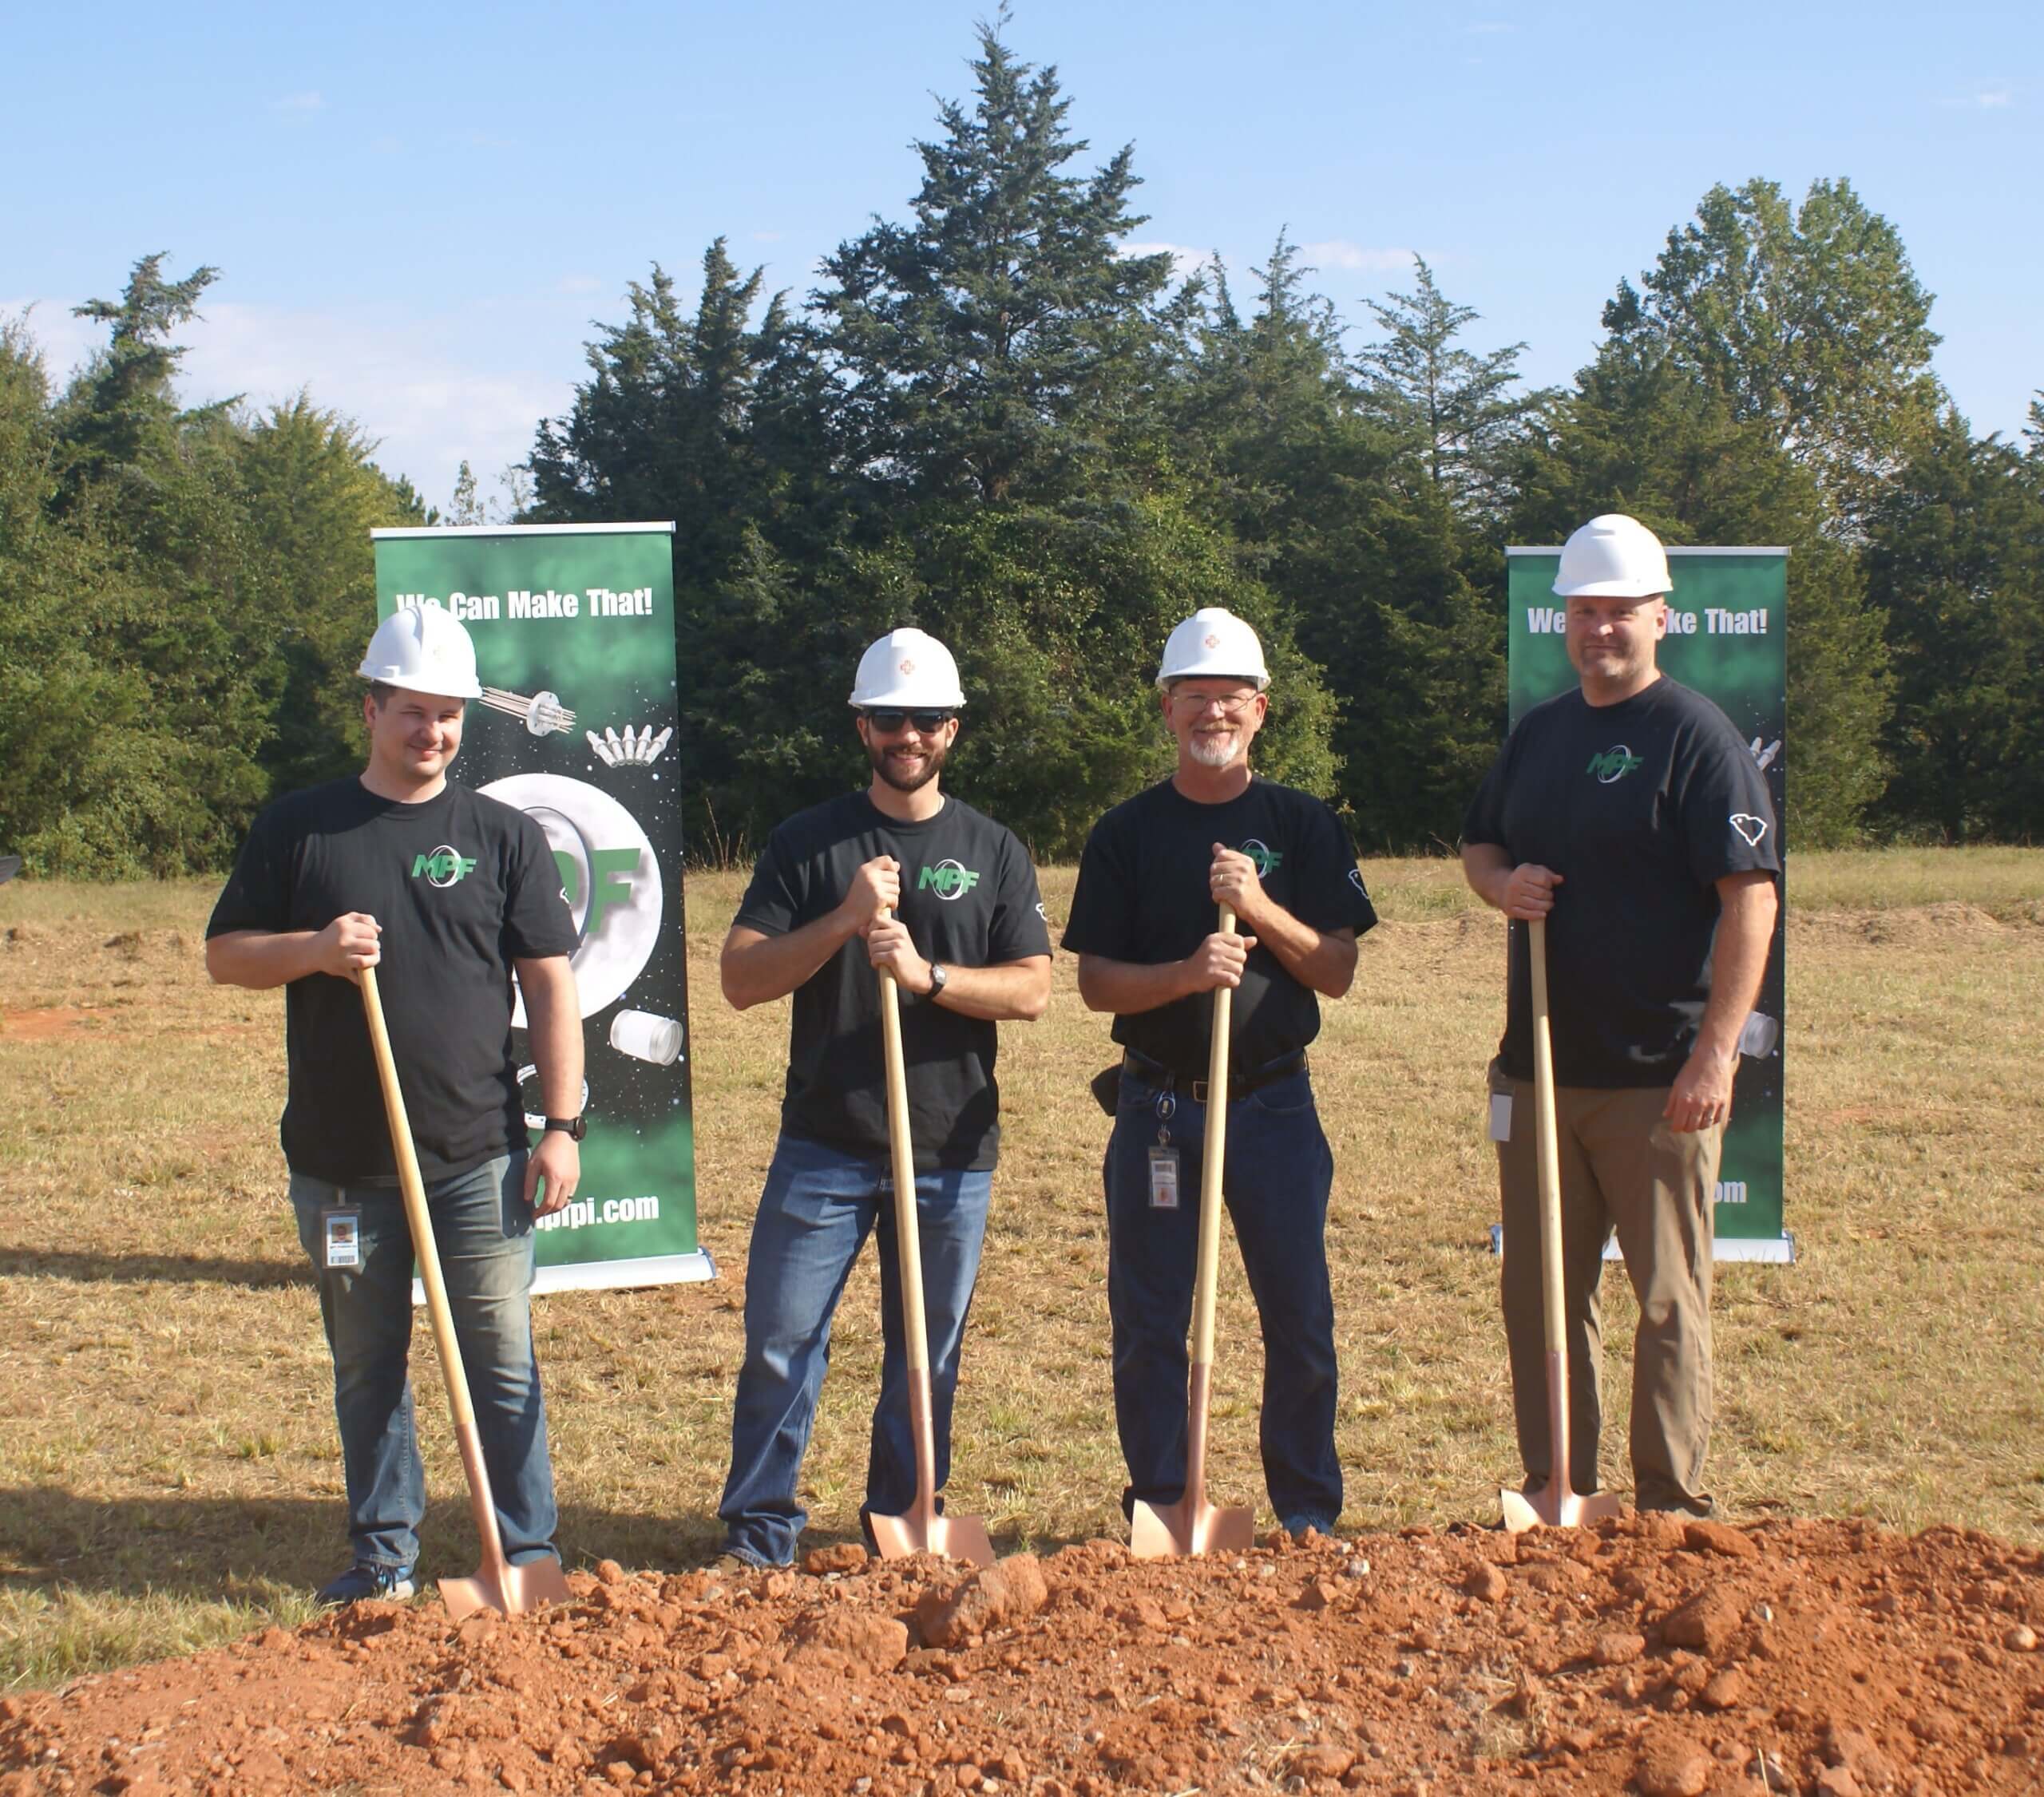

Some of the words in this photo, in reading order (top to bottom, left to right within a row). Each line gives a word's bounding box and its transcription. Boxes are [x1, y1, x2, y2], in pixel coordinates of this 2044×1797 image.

[449, 592, 501, 621] Can
[507, 590, 579, 619] Make
[586, 588, 653, 616] That!
[1527, 608, 1567, 634] We
[1666, 608, 1697, 634] ke
[1704, 608, 1768, 634] That!
[1586, 753, 1645, 777] MPF
[411, 853, 477, 881] MPF
[918, 866, 980, 894] MPF
